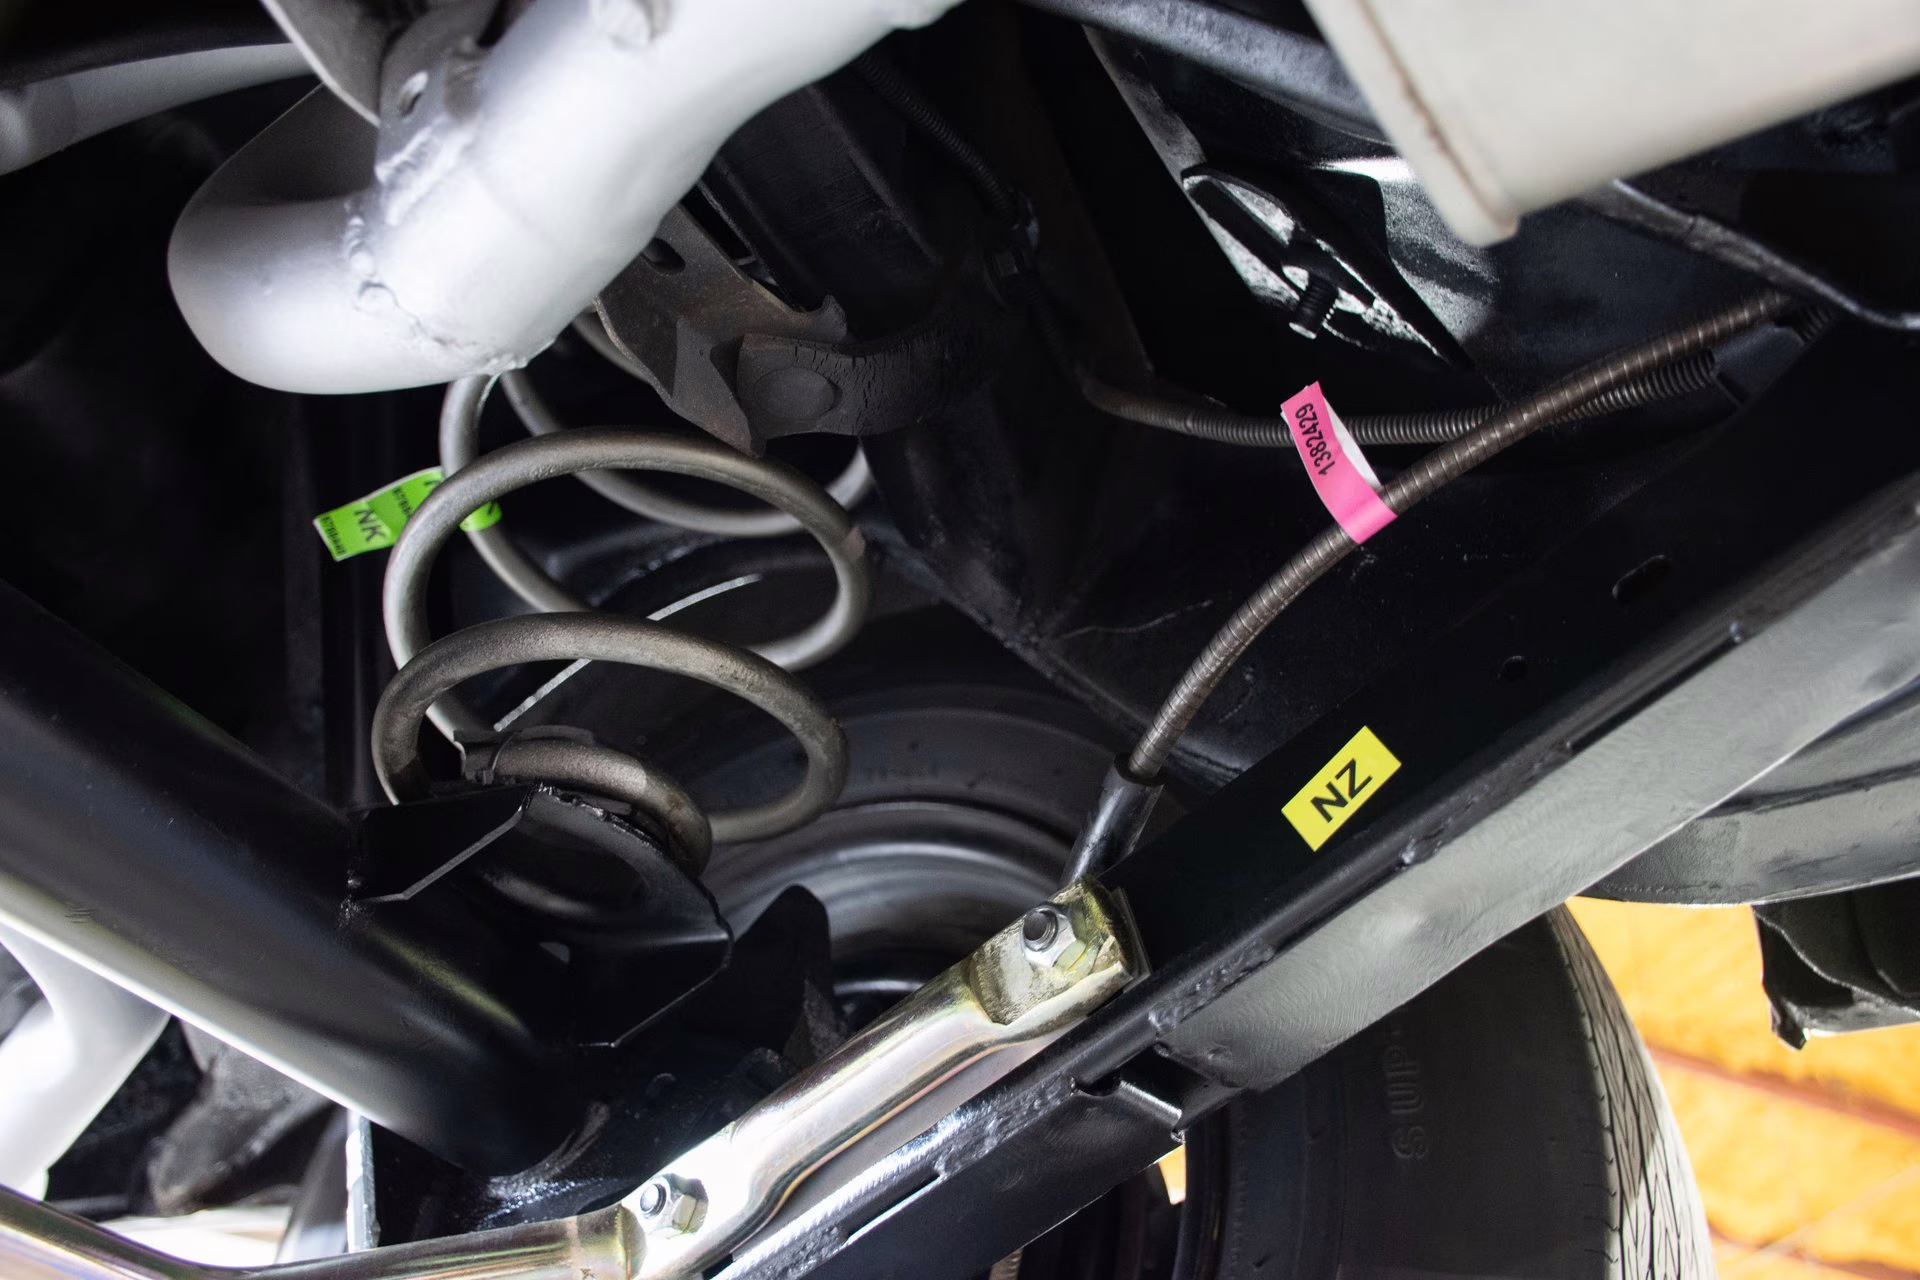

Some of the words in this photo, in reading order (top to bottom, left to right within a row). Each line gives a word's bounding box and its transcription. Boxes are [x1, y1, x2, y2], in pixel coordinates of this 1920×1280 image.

[1295, 402, 1335, 475] 1382429
[354, 509, 386, 542] NK
[1310, 757, 1373, 823] NZ
